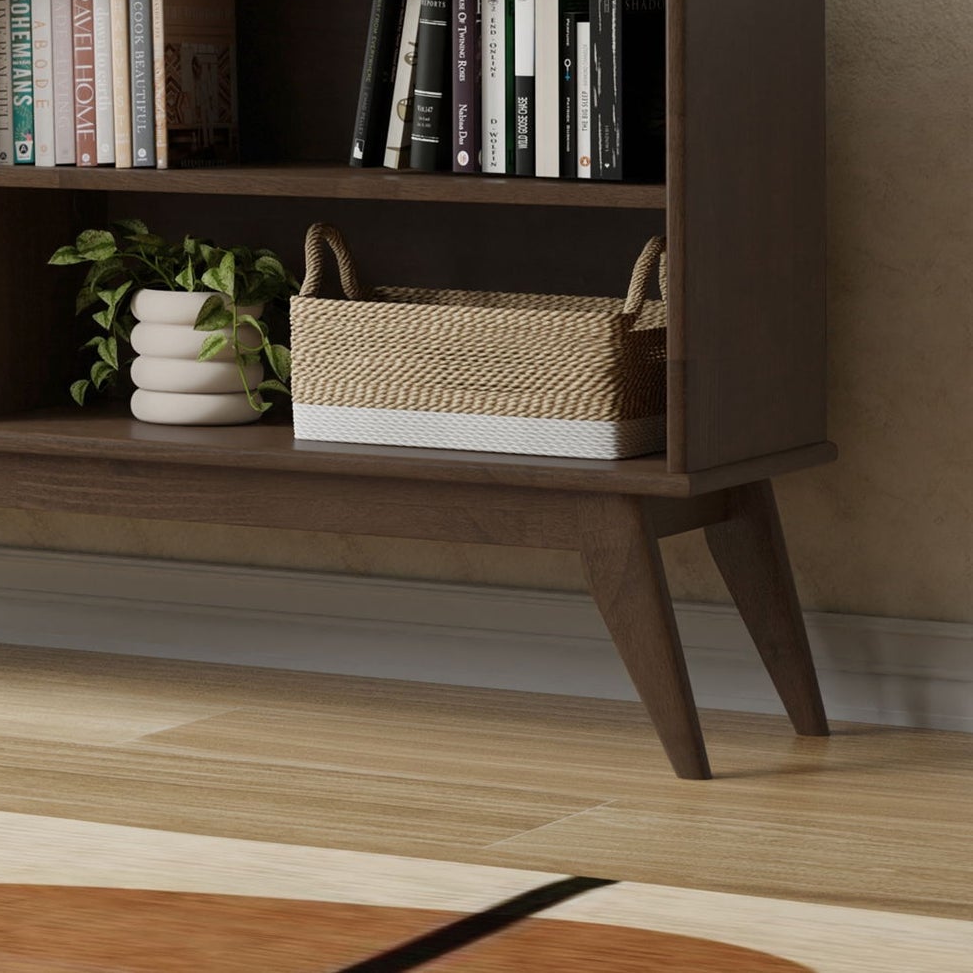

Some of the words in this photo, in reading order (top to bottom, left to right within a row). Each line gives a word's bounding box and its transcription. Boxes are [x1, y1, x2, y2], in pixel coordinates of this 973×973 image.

[133, 1, 144, 44] COOK
[372, 13, 380, 34] FROM
[457, 11, 467, 24] OF
[457, 25, 467, 59] TWINING
[33, 19, 49, 108] ABODE
[457, 59, 467, 82] ROSES
[74, 64, 96, 141] HOME
[134, 50, 146, 134] BEAUTIFUL
[517, 96, 528, 115] CHASE
[517, 115, 528, 134] GOOSE
[517, 134, 528, 149] WILD
